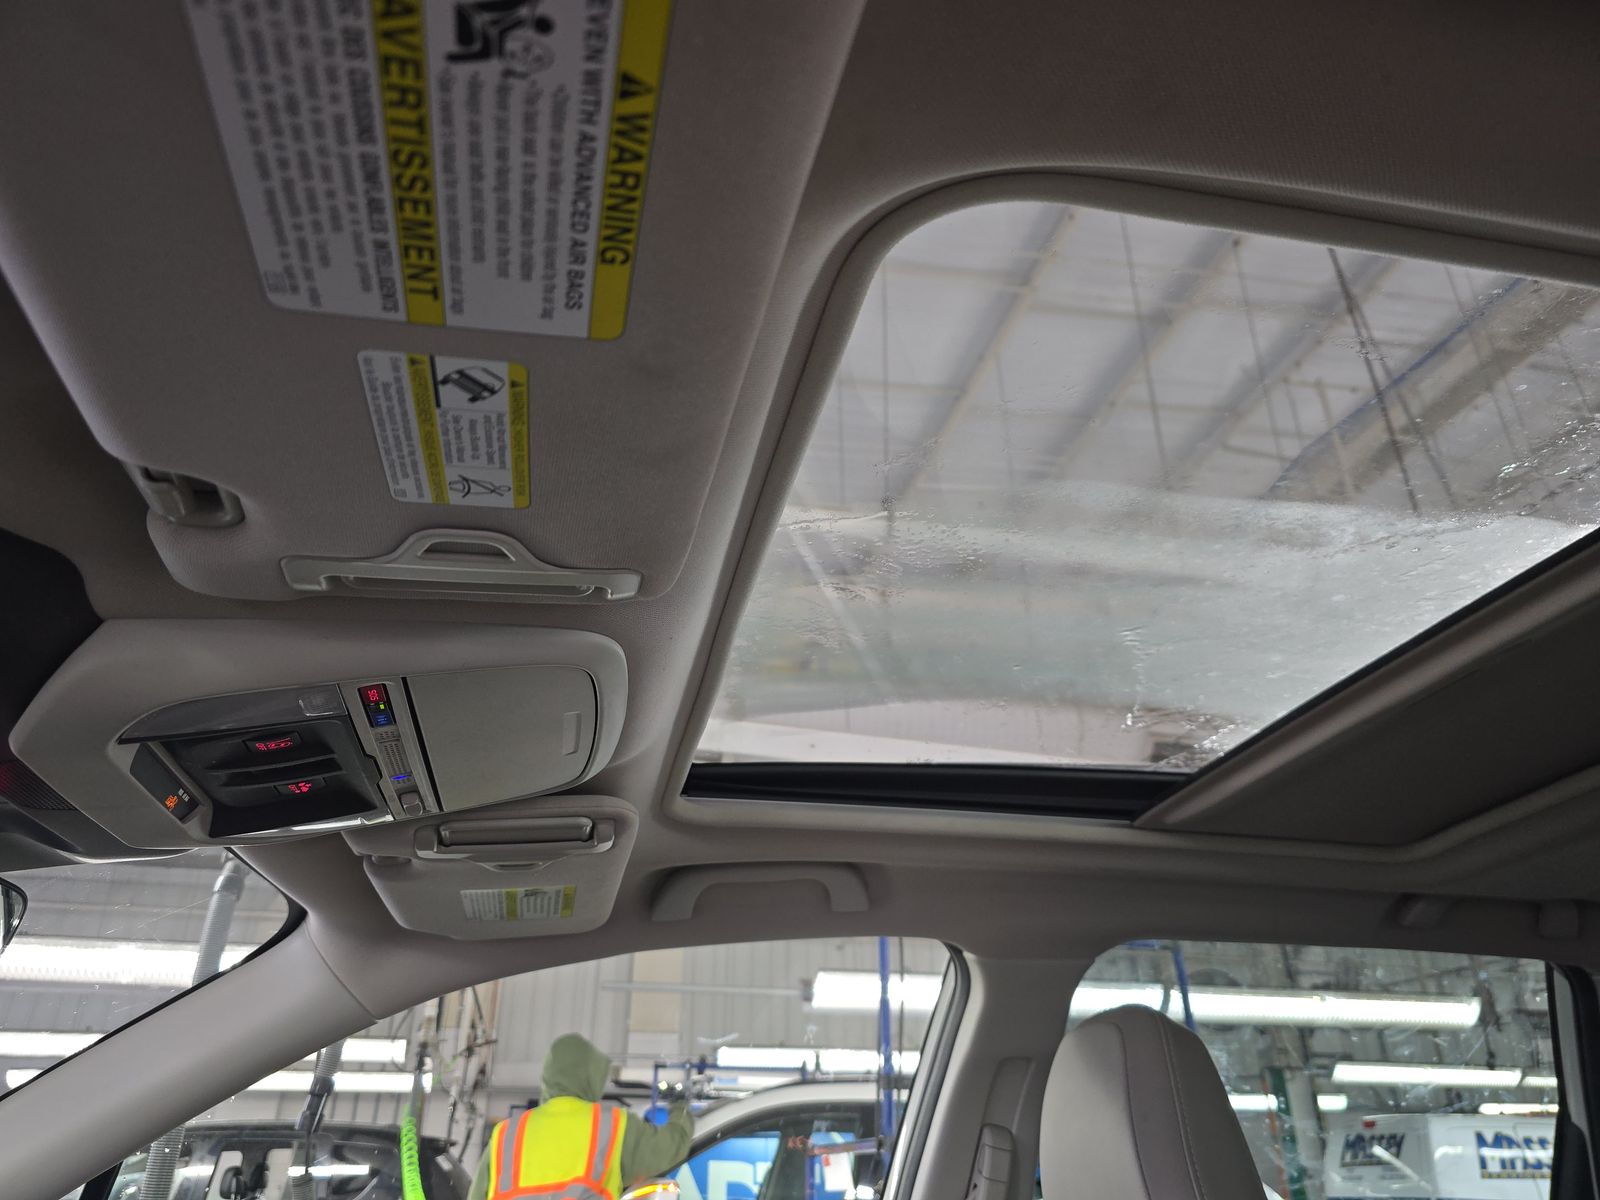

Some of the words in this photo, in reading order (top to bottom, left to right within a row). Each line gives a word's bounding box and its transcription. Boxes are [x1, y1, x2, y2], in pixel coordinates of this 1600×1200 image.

[582, 0, 613, 64] EVEN
[577, 68, 605, 125] WITH
[374, 0, 439, 302] AVERTISSEMENT
[568, 128, 598, 235] ADVANCED
[599, 112, 650, 266] WARNING
[567, 236, 588, 265] AIR
[563, 268, 586, 311] BAGS
